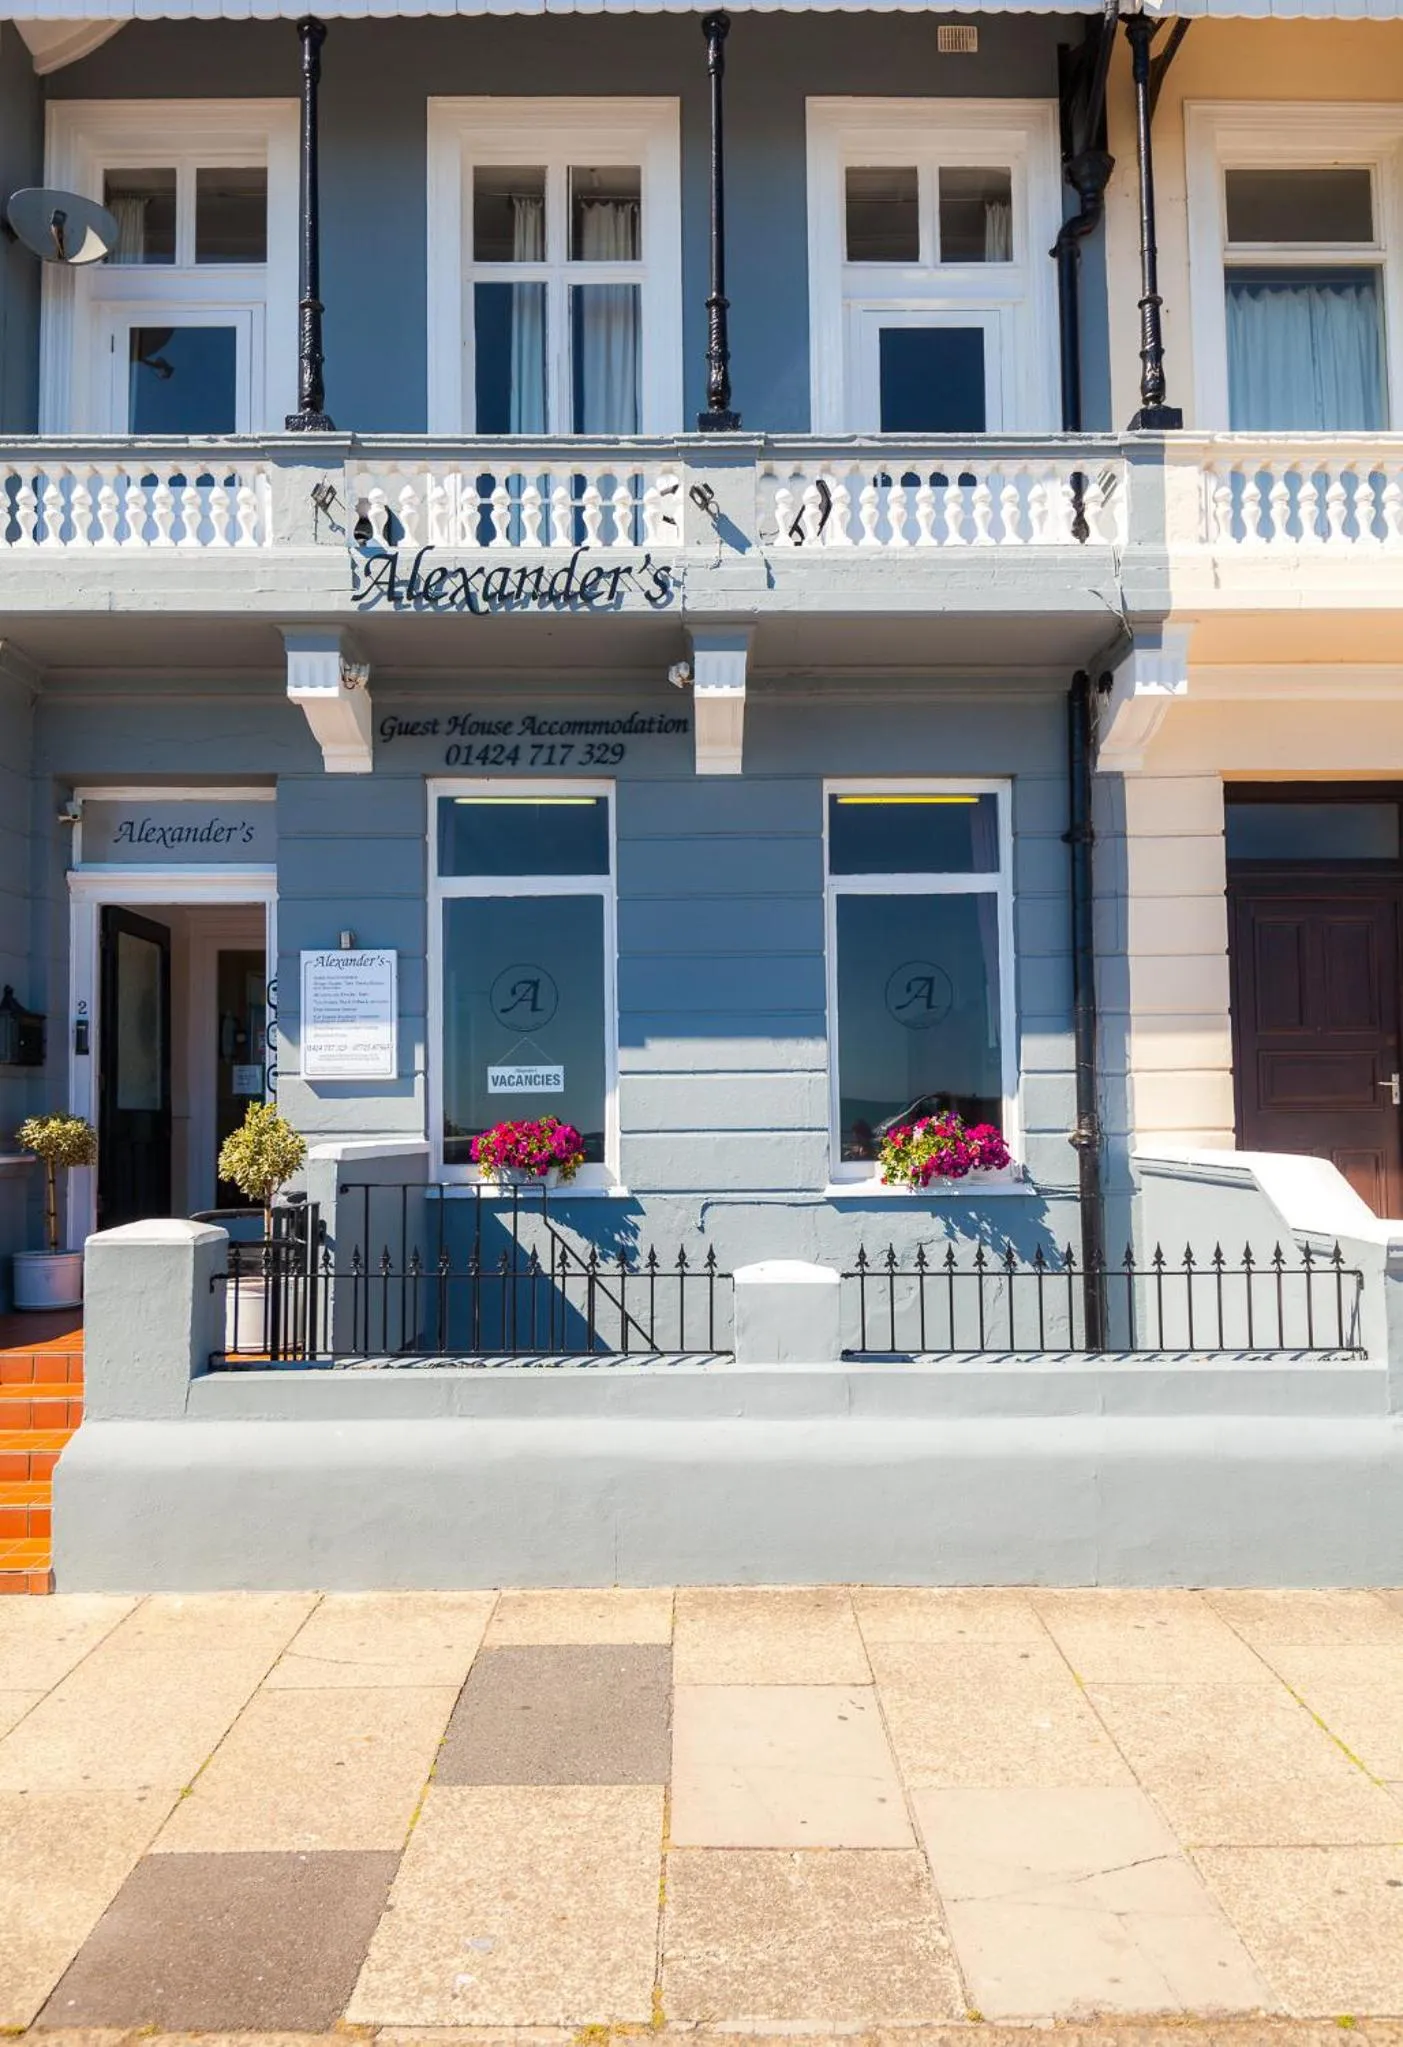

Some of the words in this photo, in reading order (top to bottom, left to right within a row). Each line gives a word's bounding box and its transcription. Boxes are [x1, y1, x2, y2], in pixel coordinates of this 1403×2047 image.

[351, 546, 672, 615] Alexander's
[380, 715, 440, 742] Guest
[445, 712, 513, 736] House
[517, 711, 689, 736] Accommodation
[445, 744, 520, 766] 01424
[529, 744, 574, 766] 717
[578, 743, 625, 765] 329
[113, 817, 255, 849] Alexander's
[314, 954, 385, 970] Alexander's
[78, 1000, 88, 1014] 2
[500, 979, 544, 1013] A
[895, 976, 938, 1010] A
[491, 1074, 560, 1087] VACANCIES
